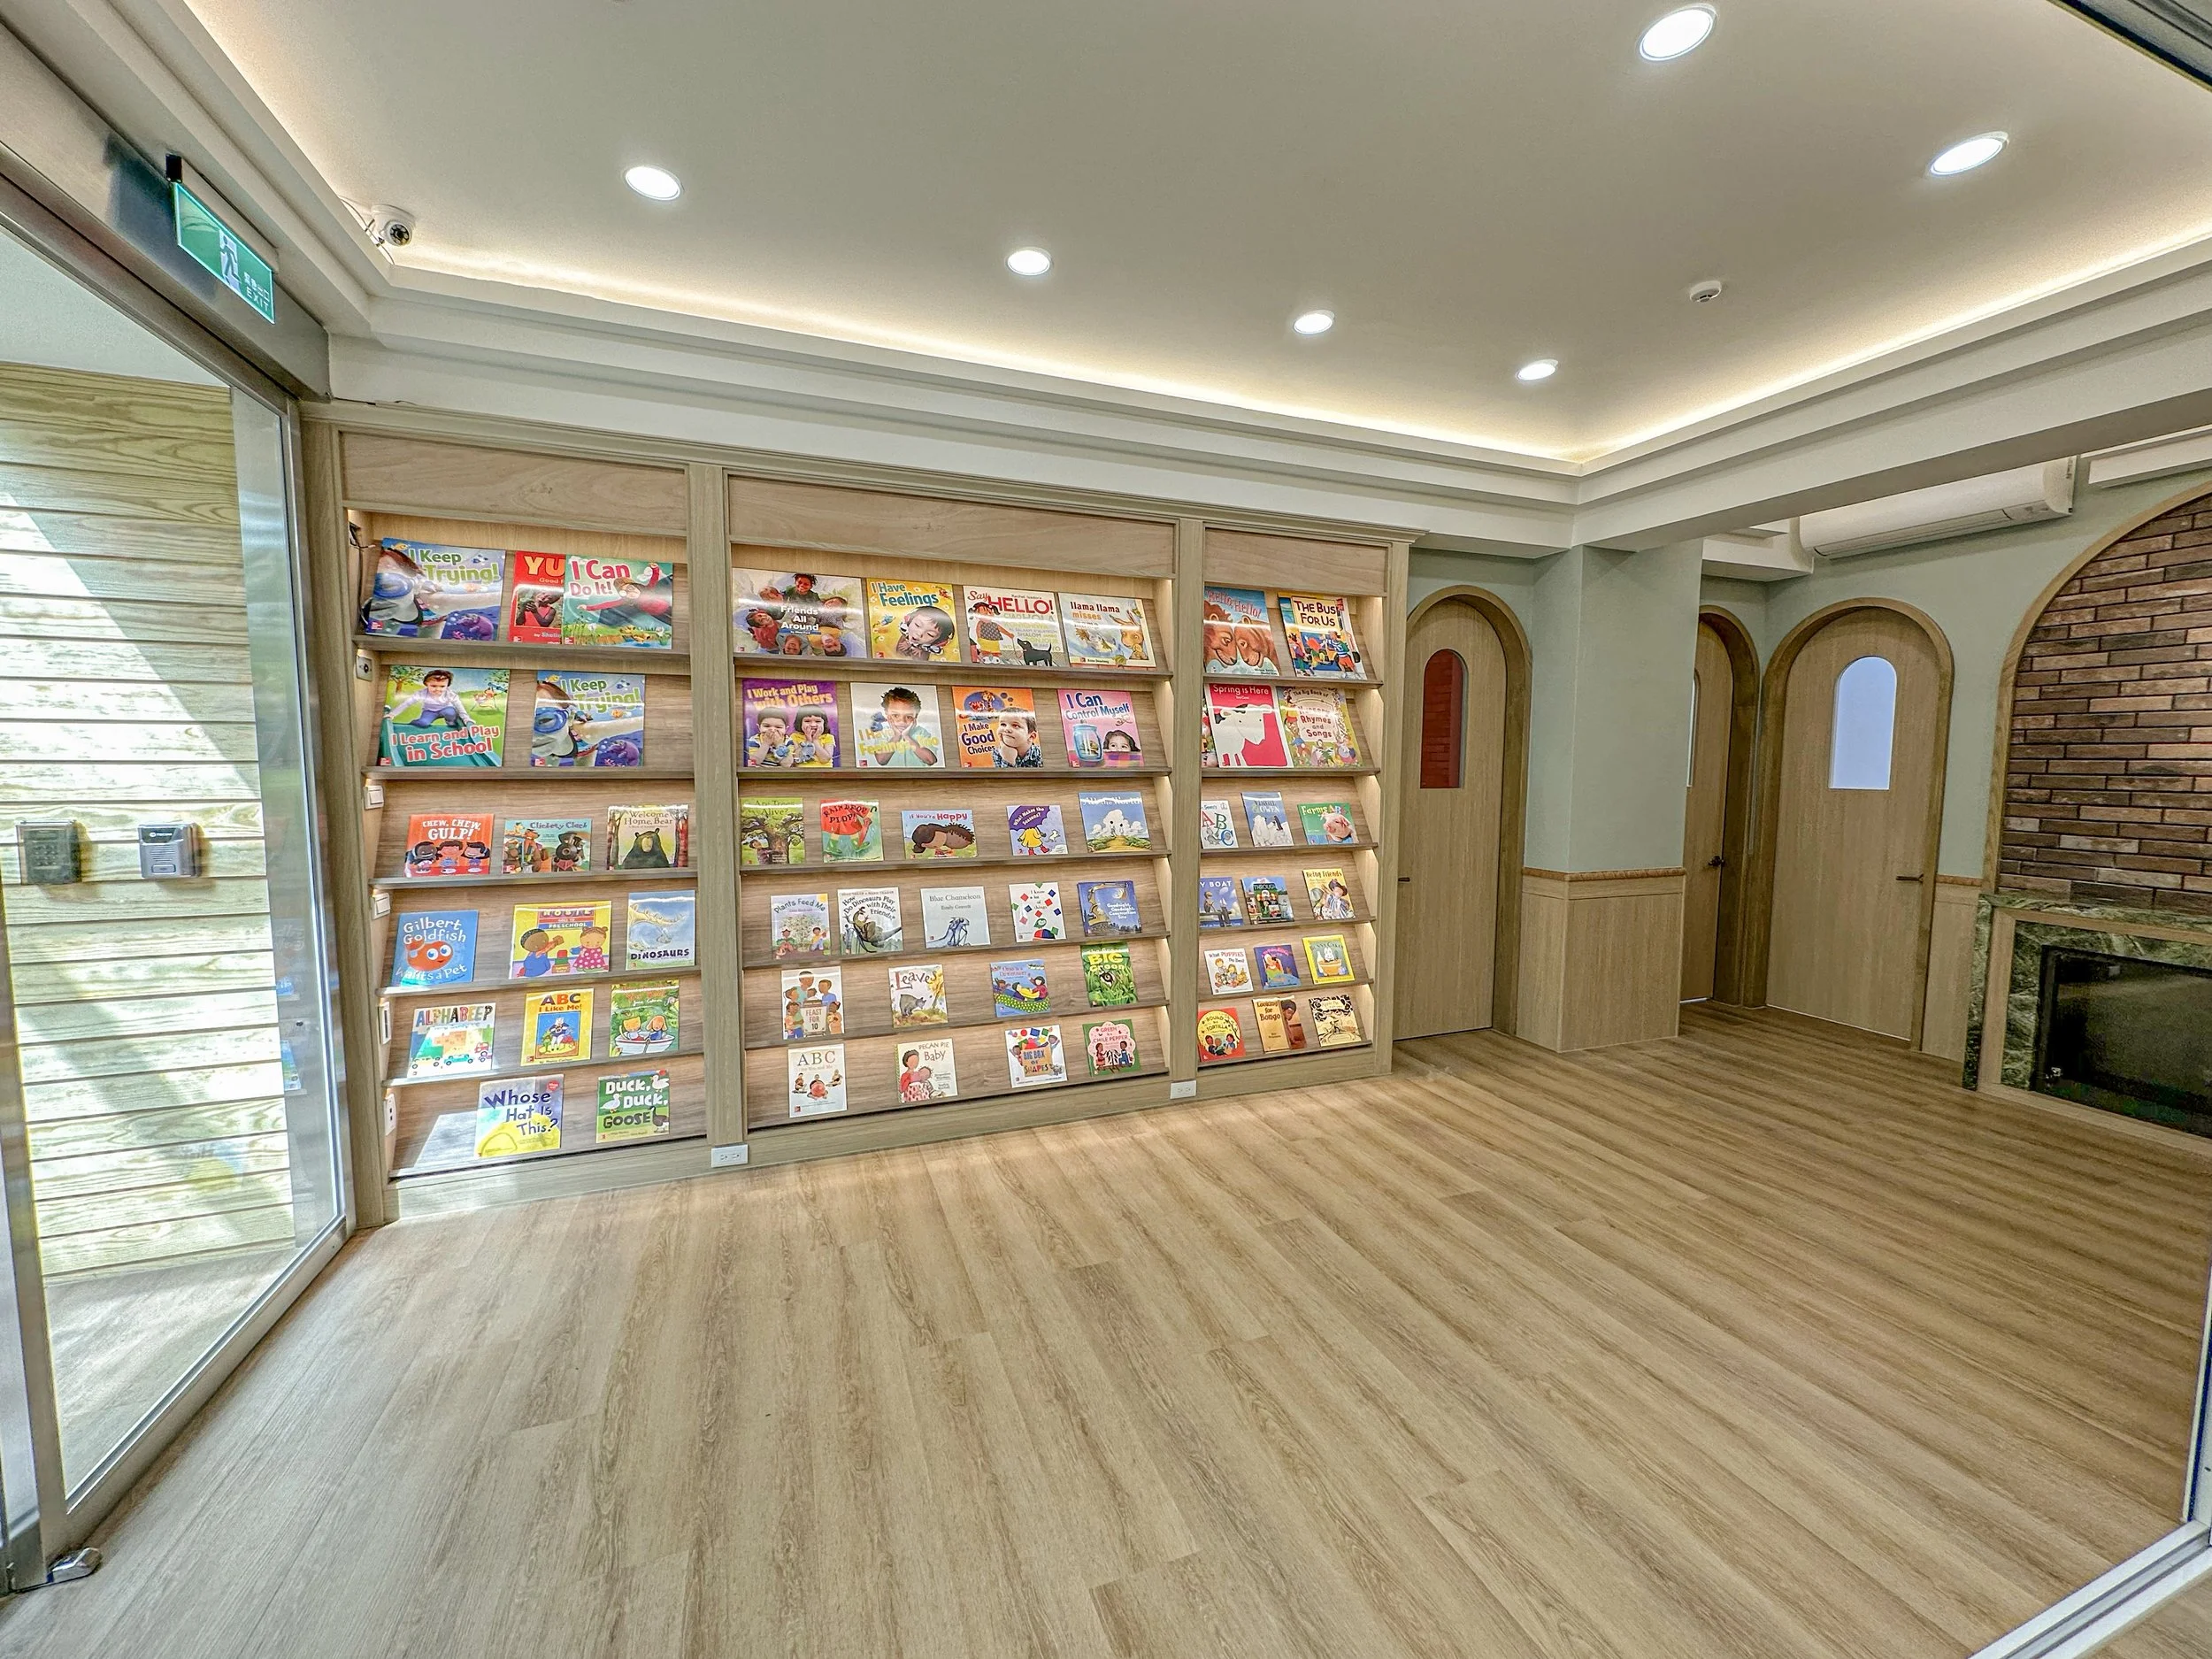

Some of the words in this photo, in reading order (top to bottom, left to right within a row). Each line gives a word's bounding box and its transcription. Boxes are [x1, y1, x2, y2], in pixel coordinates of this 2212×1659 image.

[246, 287, 269, 312] EXIT
[410, 549, 416, 562] I
[419, 549, 462, 565] Keep
[424, 564, 500, 585] Trying!
[572, 560, 580, 580] I
[586, 560, 629, 580] Can
[571, 583, 590, 596] Do
[595, 581, 612, 595] It!
[872, 582, 877, 594] I
[879, 582, 905, 593] Have
[879, 592, 939, 607] Feelings
[967, 590, 989, 603] Say
[987, 595, 1054, 615] HELLO!
[1070, 601, 1095, 611] llama
[1096, 602, 1120, 613] llama
[780, 605, 818, 616] Friends
[1294, 601, 1315, 613] THE
[1316, 602, 1336, 615] BUS
[1072, 611, 1102, 621] misses
[1301, 613, 1320, 625] FOR
[1321, 615, 1336, 627] US
[780, 621, 819, 631] Around
[571, 679, 607, 695] Keep
[747, 689, 752, 699] I
[752, 687, 779, 699] Work
[780, 686, 796, 695] and
[797, 683, 818, 695] Play
[1213, 684, 1241, 695] Spring
[1249, 686, 1270, 695] Here
[574, 688, 641, 713] Trying!
[754, 696, 786, 710] with
[787, 692, 833, 708] Others
[1066, 694, 1074, 709] I
[1076, 693, 1102, 709] Can
[1065, 707, 1099, 721] Control
[1101, 703, 1131, 719] Myself
[964, 724, 968, 733] I
[969, 722, 989, 732] Make
[1300, 715, 1332, 725] Rhymes
[392, 734, 397, 746] I
[401, 732, 439, 746] Learn
[442, 729, 467, 741] and
[470, 726, 500, 740] Play
[961, 730, 995, 746] Good
[1306, 729, 1332, 738] Songs
[407, 746, 428, 761] in
[430, 738, 492, 760] School
[968, 745, 996, 756] Choices
[937, 813, 968, 822] Happy
[1301, 805, 1328, 816] Farms
[428, 827, 475, 841] GULP!
[773, 901, 796, 913] Plants
[815, 902, 826, 911] Me
[842, 896, 856, 906] How
[843, 905, 854, 914] Do
[852, 896, 882, 908] Dinosaurs
[883, 895, 895, 905] Play
[403, 917, 462, 933] Gilbert
[403, 929, 466, 945] Goldfish
[631, 949, 689, 960] DINOSAURS
[895, 971, 937, 991] Leaves
[541, 993, 580, 1006] ABC
[416, 1005, 493, 1027] ALPHABEEP
[924, 1049, 946, 1061] Baby
[605, 1079, 651, 1094] DUCK,
[484, 1089, 551, 1110] Whose
[623, 1094, 669, 1109] DUCK,
[506, 1105, 534, 1122] Hat
[541, 1106, 552, 1116] Is
[603, 1112, 650, 1129] GOOSE
[517, 1118, 558, 1136] This?
